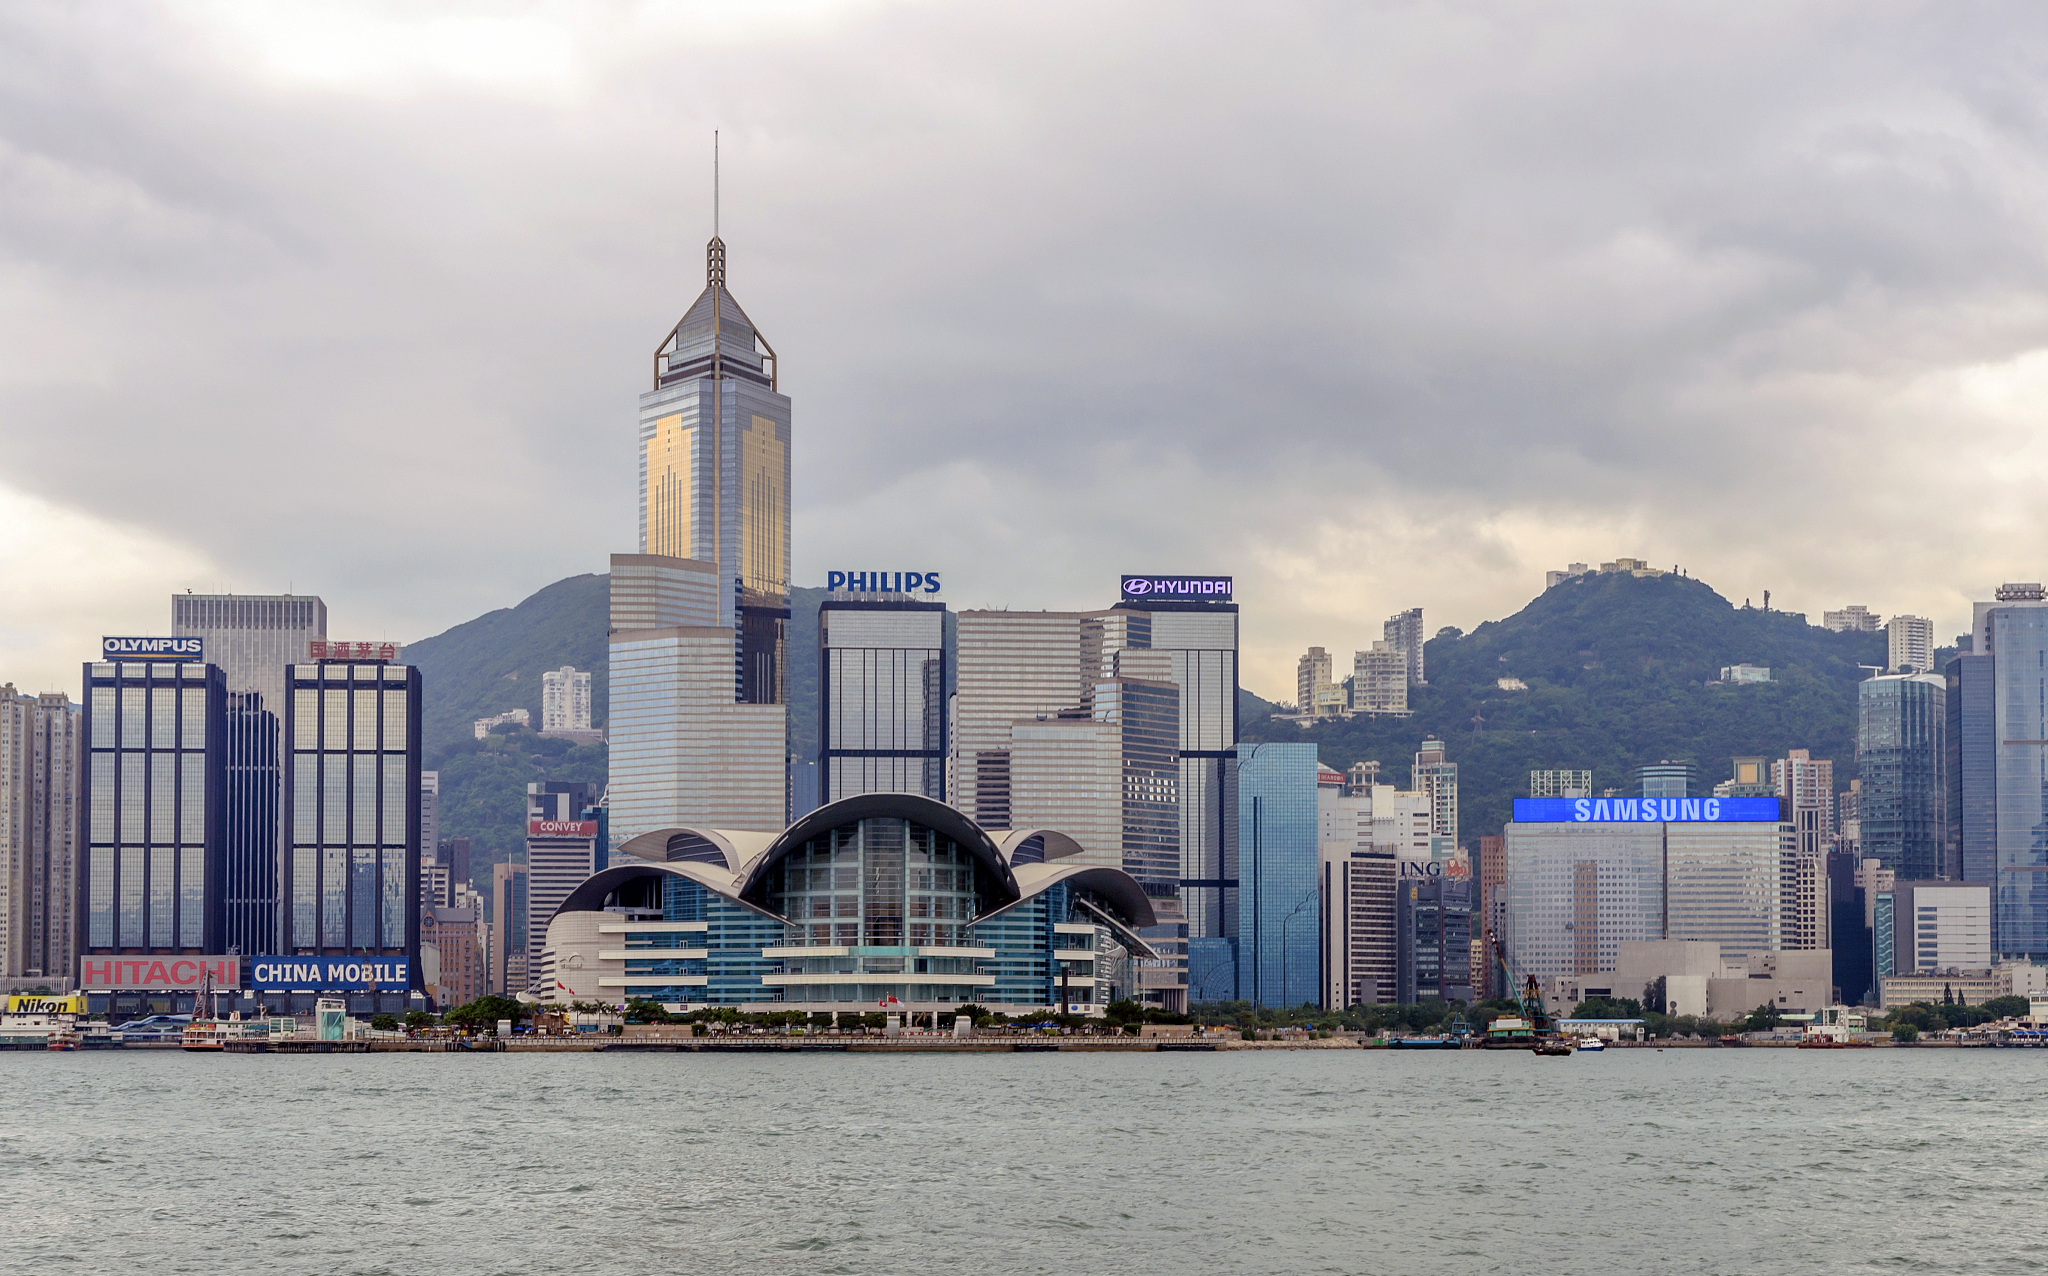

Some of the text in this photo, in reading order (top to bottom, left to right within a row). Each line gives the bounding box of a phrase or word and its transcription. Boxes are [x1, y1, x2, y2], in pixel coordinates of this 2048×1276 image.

[828, 571, 941, 593] PHILIPS
[1154, 580, 1232, 594] HYUNDAI
[104, 638, 202, 652] OLYMPUS
[311, 641, 396, 659] 国酒茅台
[1574, 799, 1720, 822] SAMSUNG
[540, 822, 583, 832] CONVEY
[1400, 861, 1440, 877] ING
[85, 960, 236, 985] HITACHI
[254, 963, 407, 982] CHINA MOBILE
[17, 998, 68, 1013] Nikon
